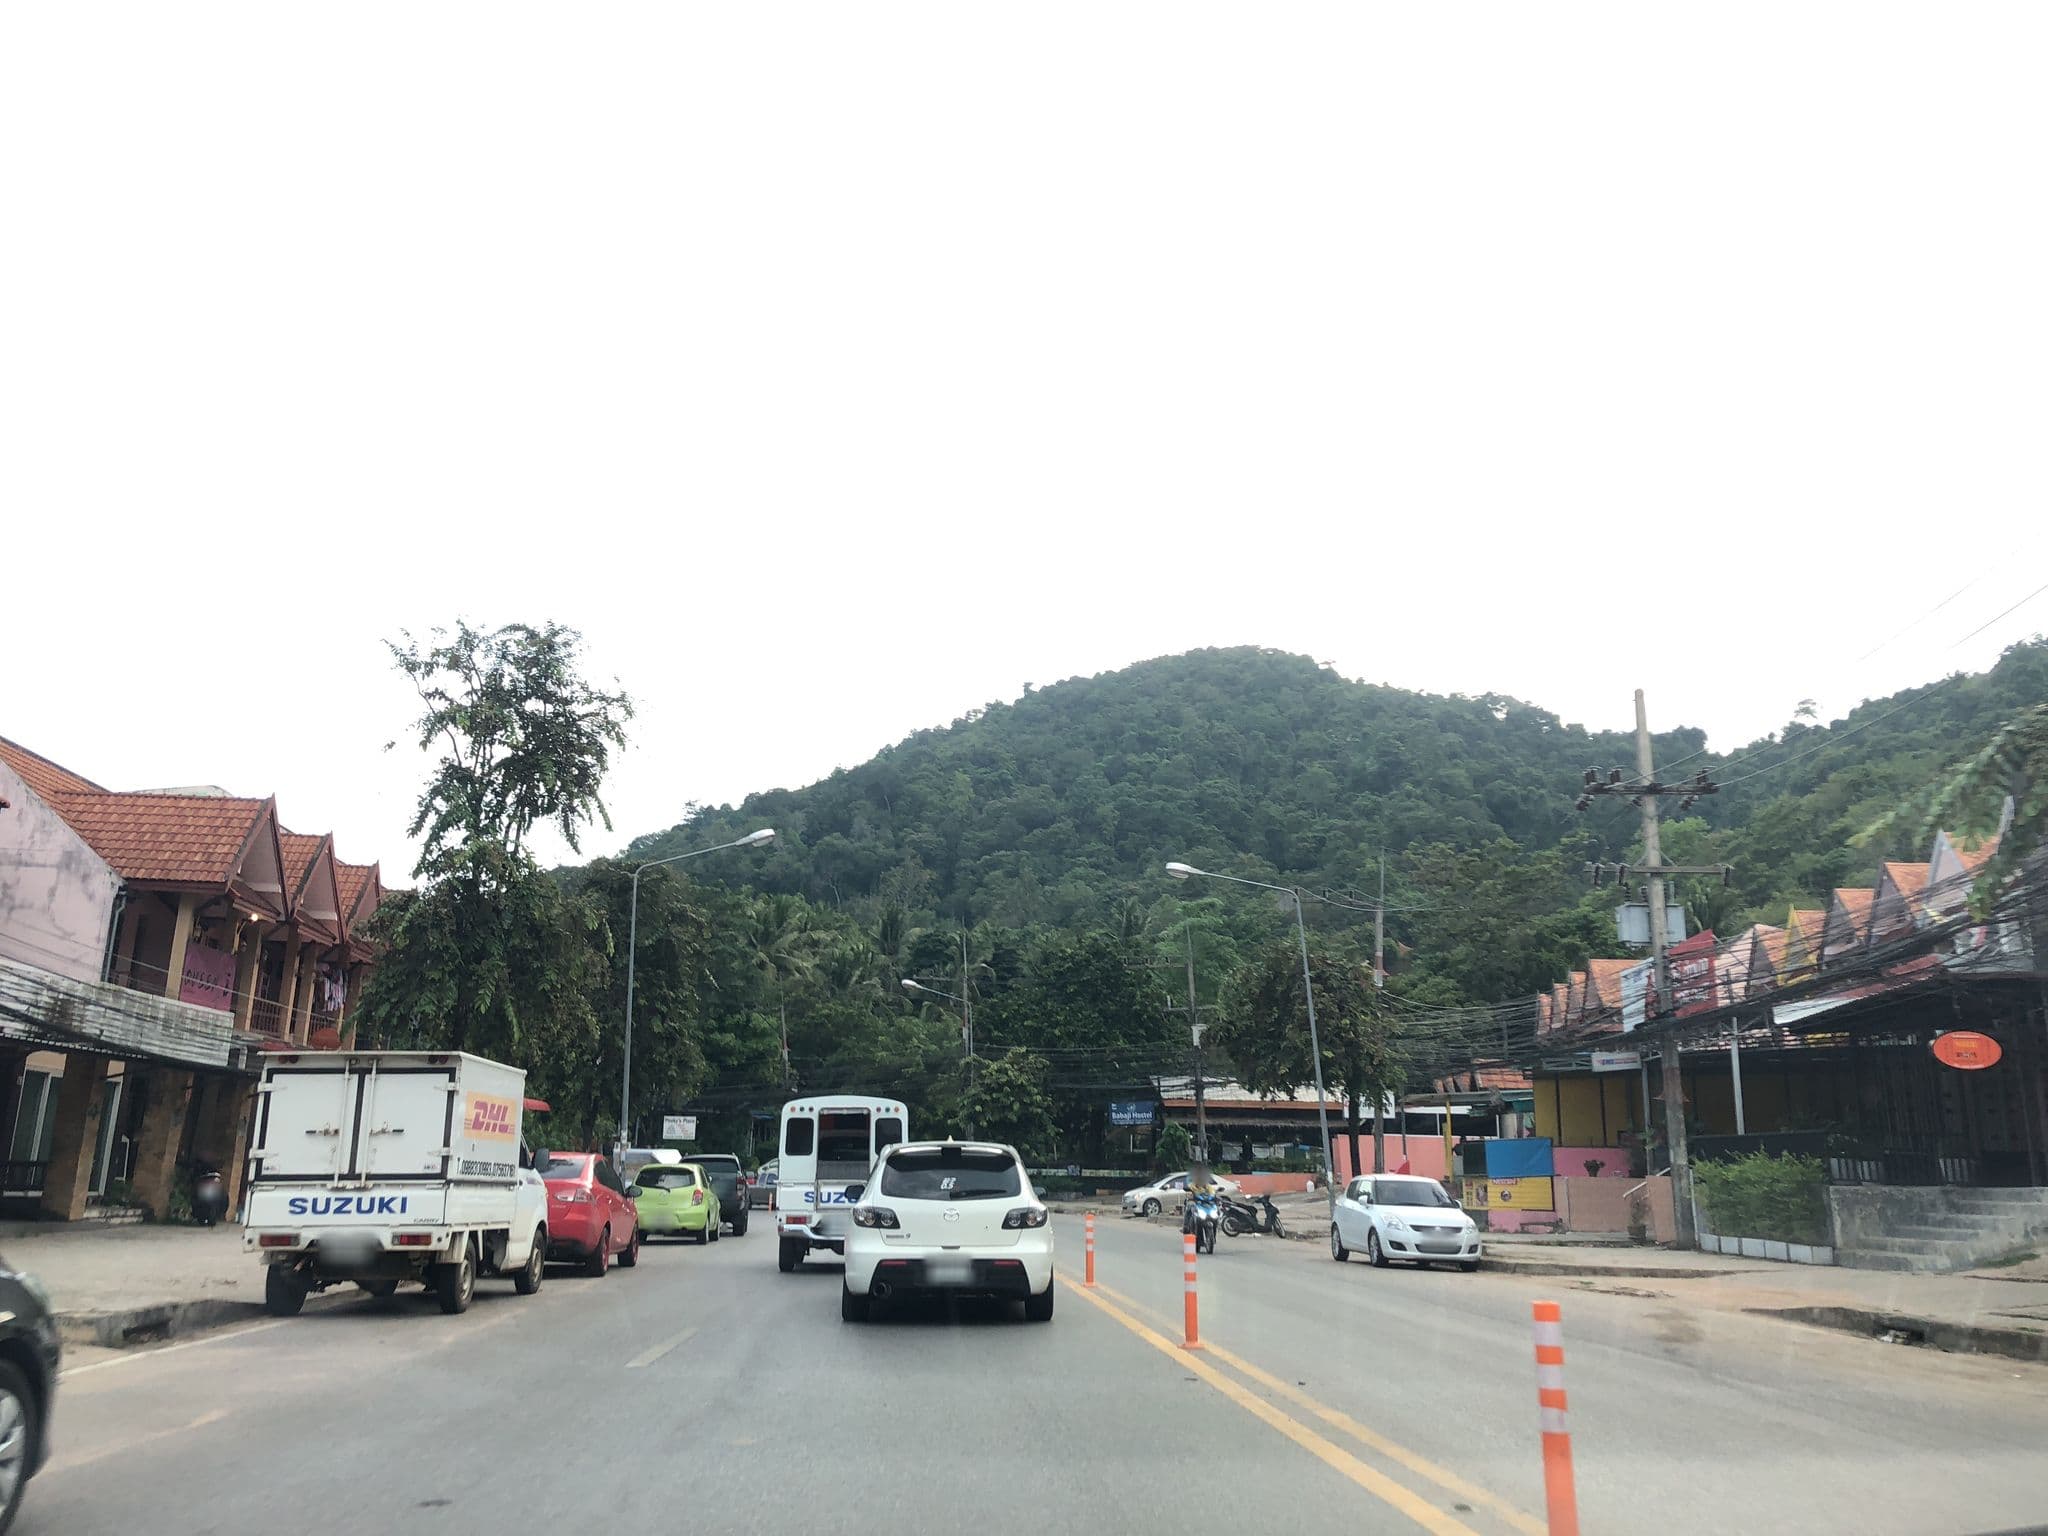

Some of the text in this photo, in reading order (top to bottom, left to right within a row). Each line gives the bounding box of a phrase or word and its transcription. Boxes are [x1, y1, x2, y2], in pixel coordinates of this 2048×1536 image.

[472, 1101, 509, 1133] DHL
[1132, 1111, 1153, 1120] Hostel
[288, 1196, 408, 1215] SUZUKI
